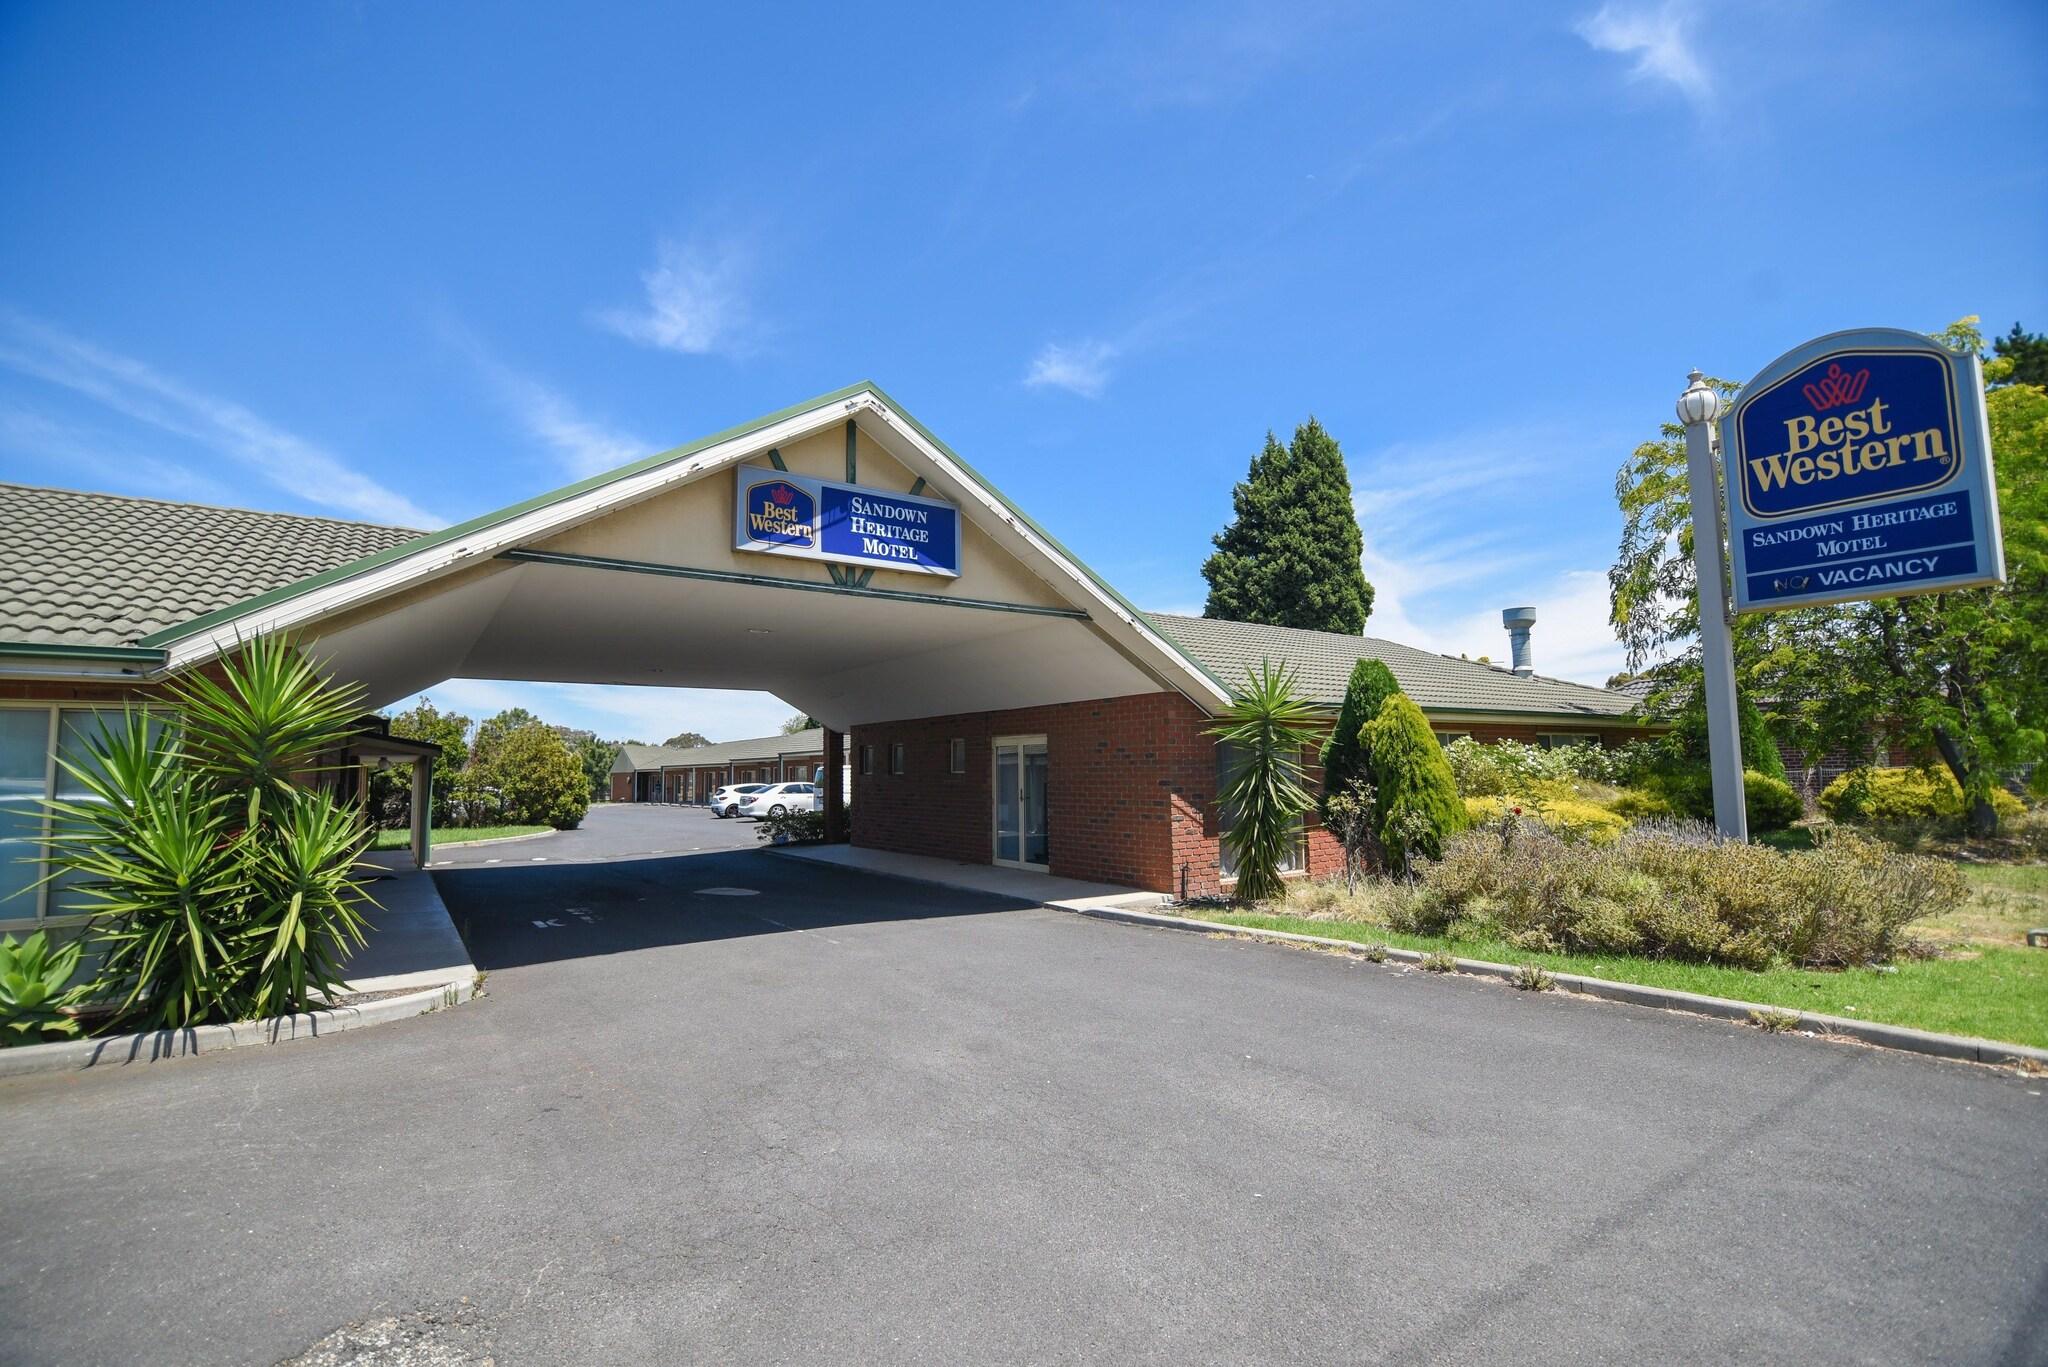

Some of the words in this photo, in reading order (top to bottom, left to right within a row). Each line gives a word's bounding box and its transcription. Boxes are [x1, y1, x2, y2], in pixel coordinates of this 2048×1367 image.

[1784, 397, 1892, 455] Best
[1749, 428, 1948, 492] Western
[763, 501, 798, 522] Best
[851, 497, 928, 524] SANDOWN
[750, 513, 812, 539] Western
[850, 517, 929, 543] HERITAGE
[1752, 520, 1844, 548] SANDOWN
[1851, 501, 1958, 532] HERITAGE
[862, 538, 918, 560] MOTEL
[1816, 535, 1888, 558] MOTEL
[1817, 556, 1940, 586] VACANCY
